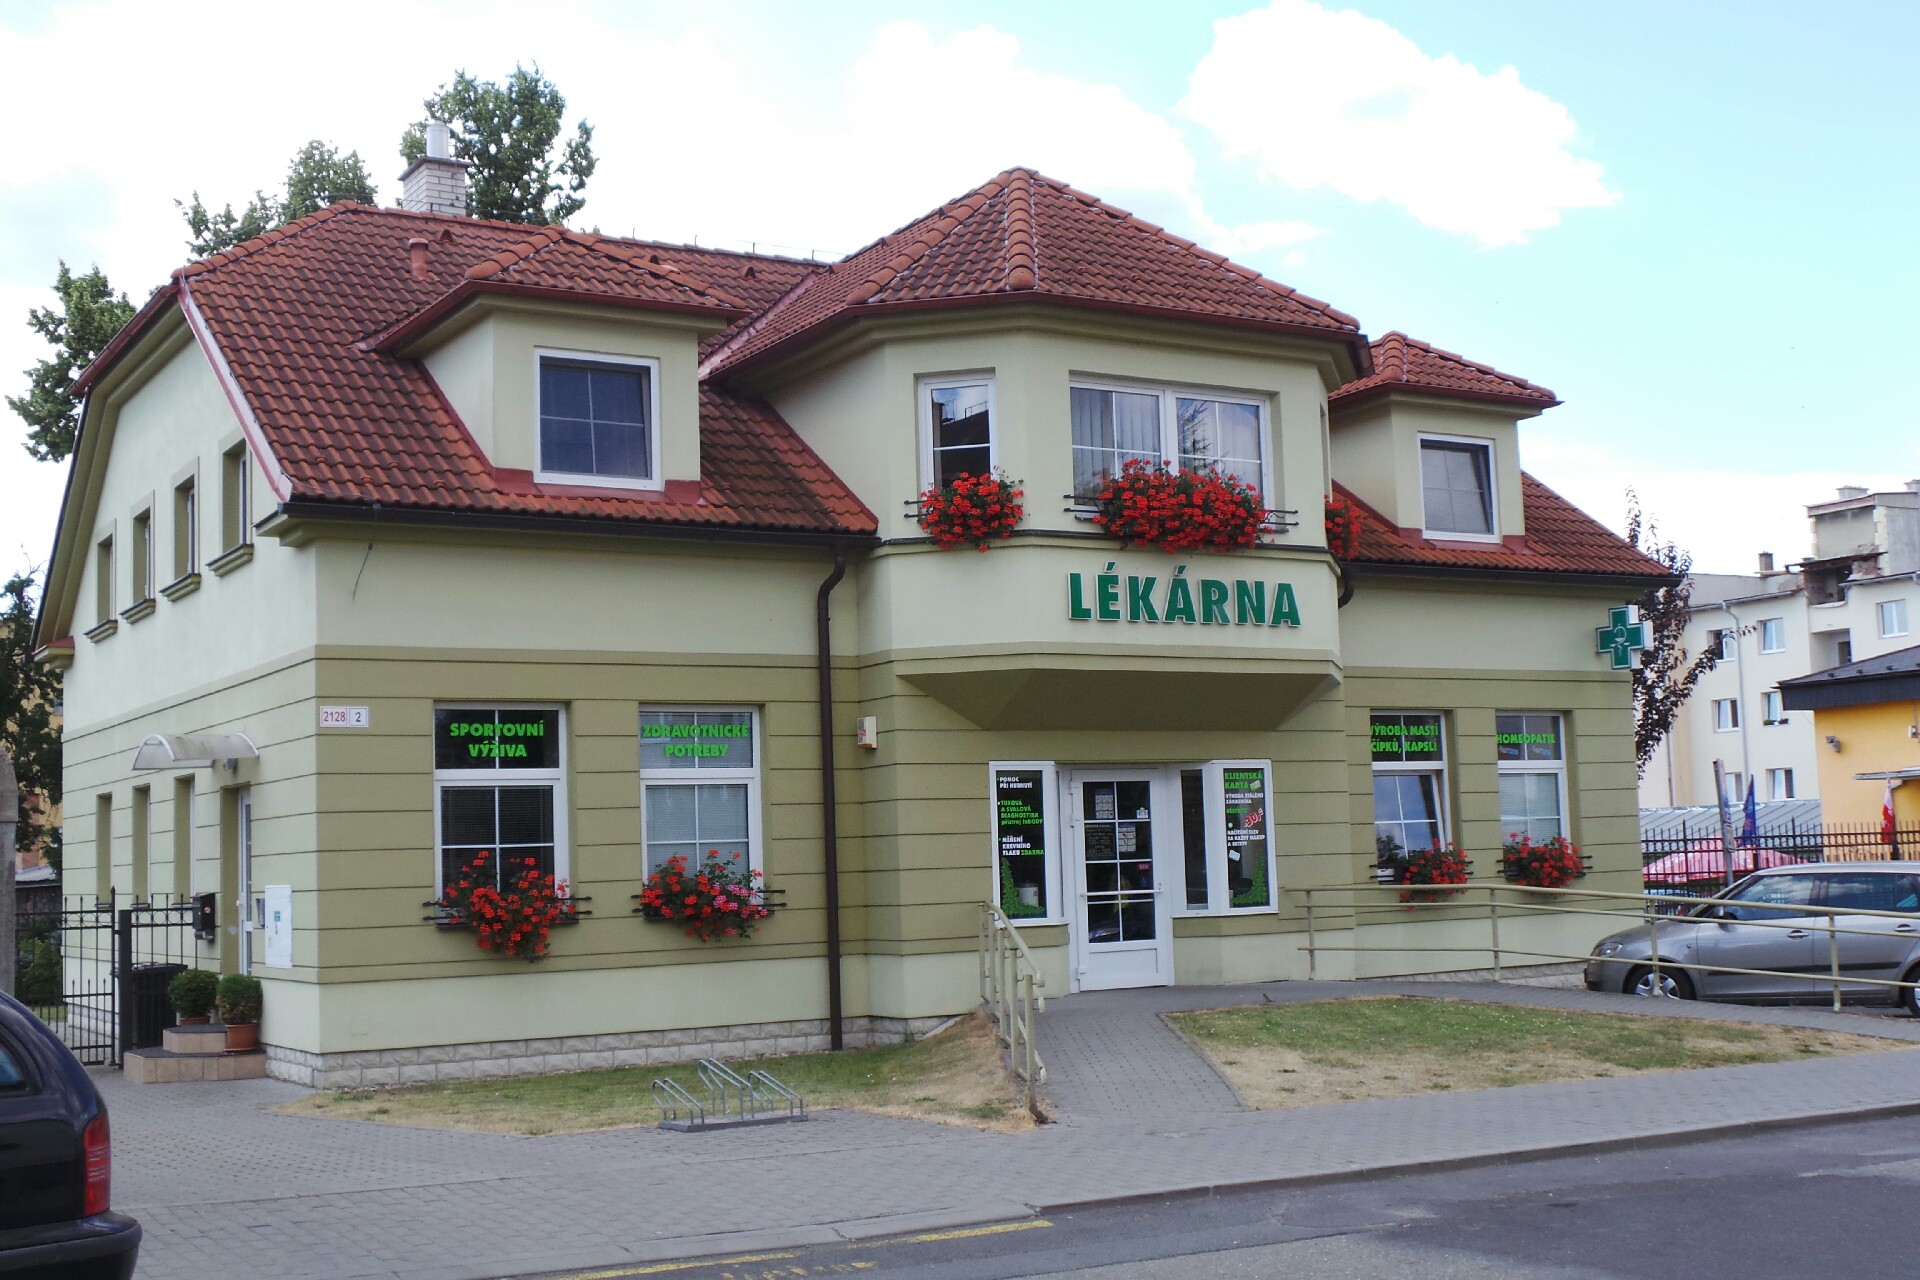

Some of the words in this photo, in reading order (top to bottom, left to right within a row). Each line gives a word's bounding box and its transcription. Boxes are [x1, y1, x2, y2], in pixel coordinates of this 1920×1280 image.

[1067, 561, 1301, 627] LÉKÁRNA
[323, 711, 346, 723] 2128
[355, 712, 361, 723] 2
[450, 720, 544, 737] SPORTOVNÍ
[642, 721, 749, 738] ZDRAVOTNICKÉ
[1410, 723, 1439, 736] MASTÍ
[1495, 733, 1556, 744] HOMEOPATIE
[468, 740, 527, 757] VÝŽIVA
[664, 741, 728, 757] POTŘEBY
[1404, 739, 1438, 752] KAPSLÍ
[1224, 771, 1263, 780] KLIENTSKÁ
[1225, 781, 1249, 789] KARTA
